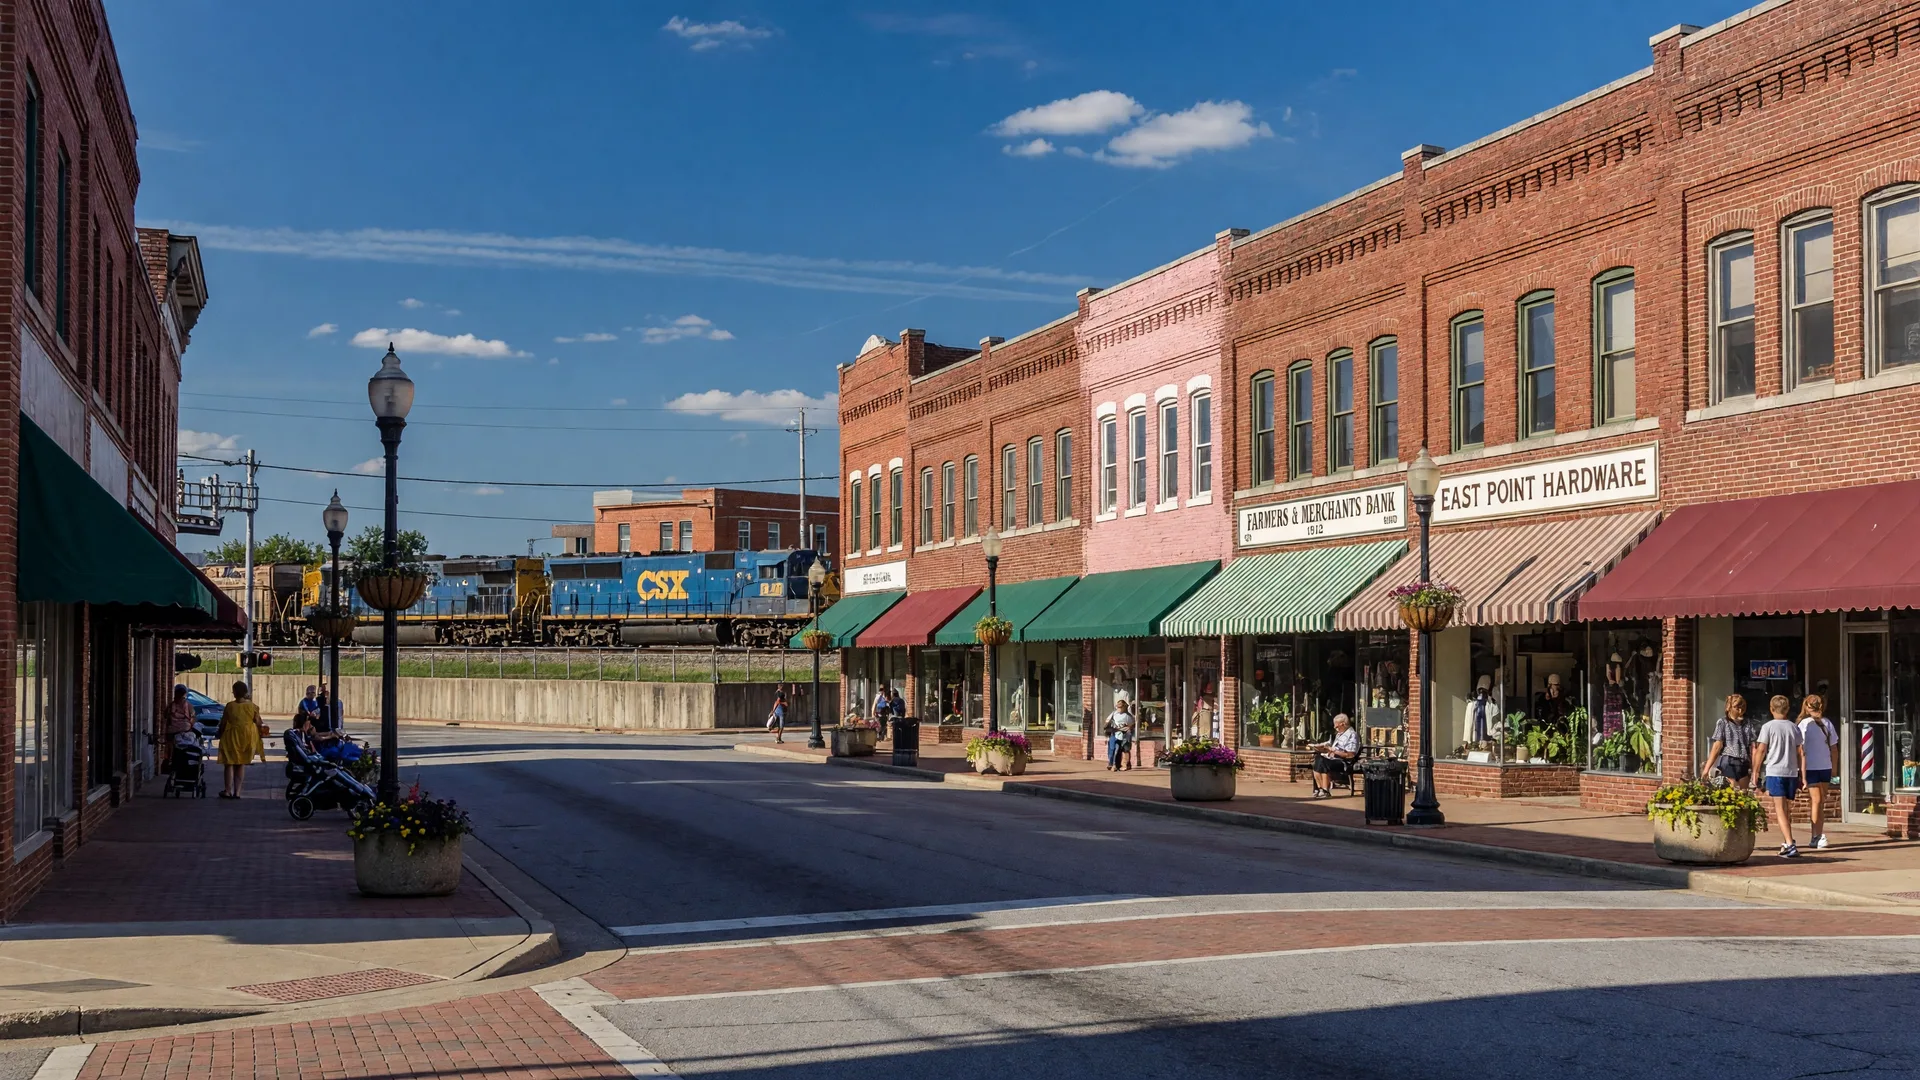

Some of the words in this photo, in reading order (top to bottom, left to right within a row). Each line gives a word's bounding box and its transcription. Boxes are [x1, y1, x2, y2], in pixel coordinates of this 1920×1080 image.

[1441, 483, 1481, 511] EAST
[1487, 475, 1535, 505] POINT
[1543, 458, 1646, 498] HARDWARE
[1247, 508, 1289, 531] FARMERS
[1291, 506, 1298, 525] &
[1301, 496, 1361, 524] MERCHANTS
[1366, 491, 1396, 515] BANK
[637, 570, 689, 601] CSX
